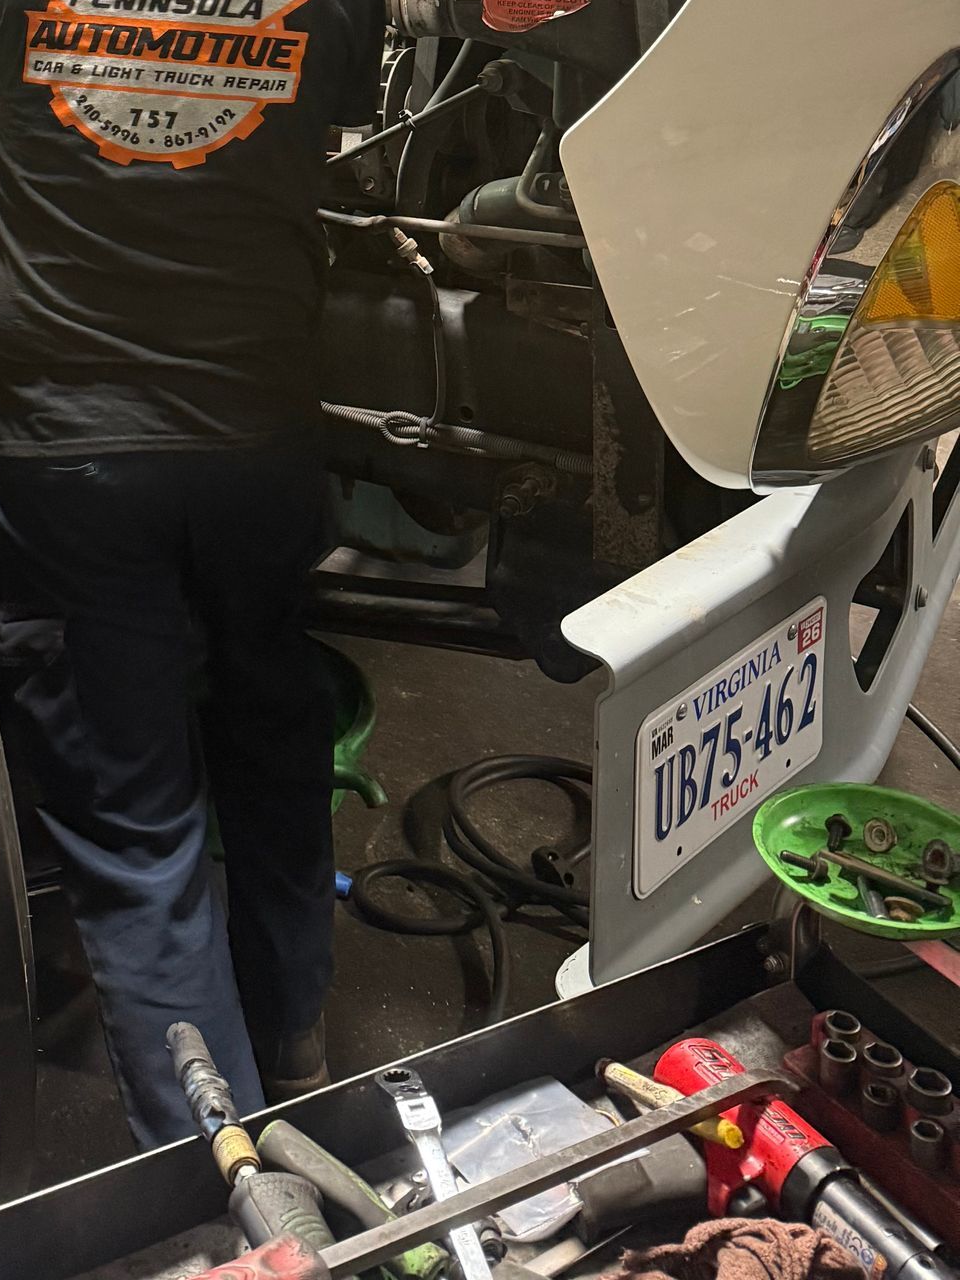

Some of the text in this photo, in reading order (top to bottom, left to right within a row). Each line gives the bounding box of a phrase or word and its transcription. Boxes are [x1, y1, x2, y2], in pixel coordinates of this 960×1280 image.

[29, 19, 300, 69] AUTOMOTIVE
[33, 60, 288, 91] CAR & LIGHT TRUCK REPAIR
[75, 94, 236, 148] 240-5996 867-9192
[129, 108, 178, 129] 757
[802, 622, 820, 648] 26
[692, 641, 782, 721] VIRGINIA
[651, 725, 674, 760] MAR
[654, 652, 818, 841] UB75-462
[711, 768, 759, 822] TRUCK
